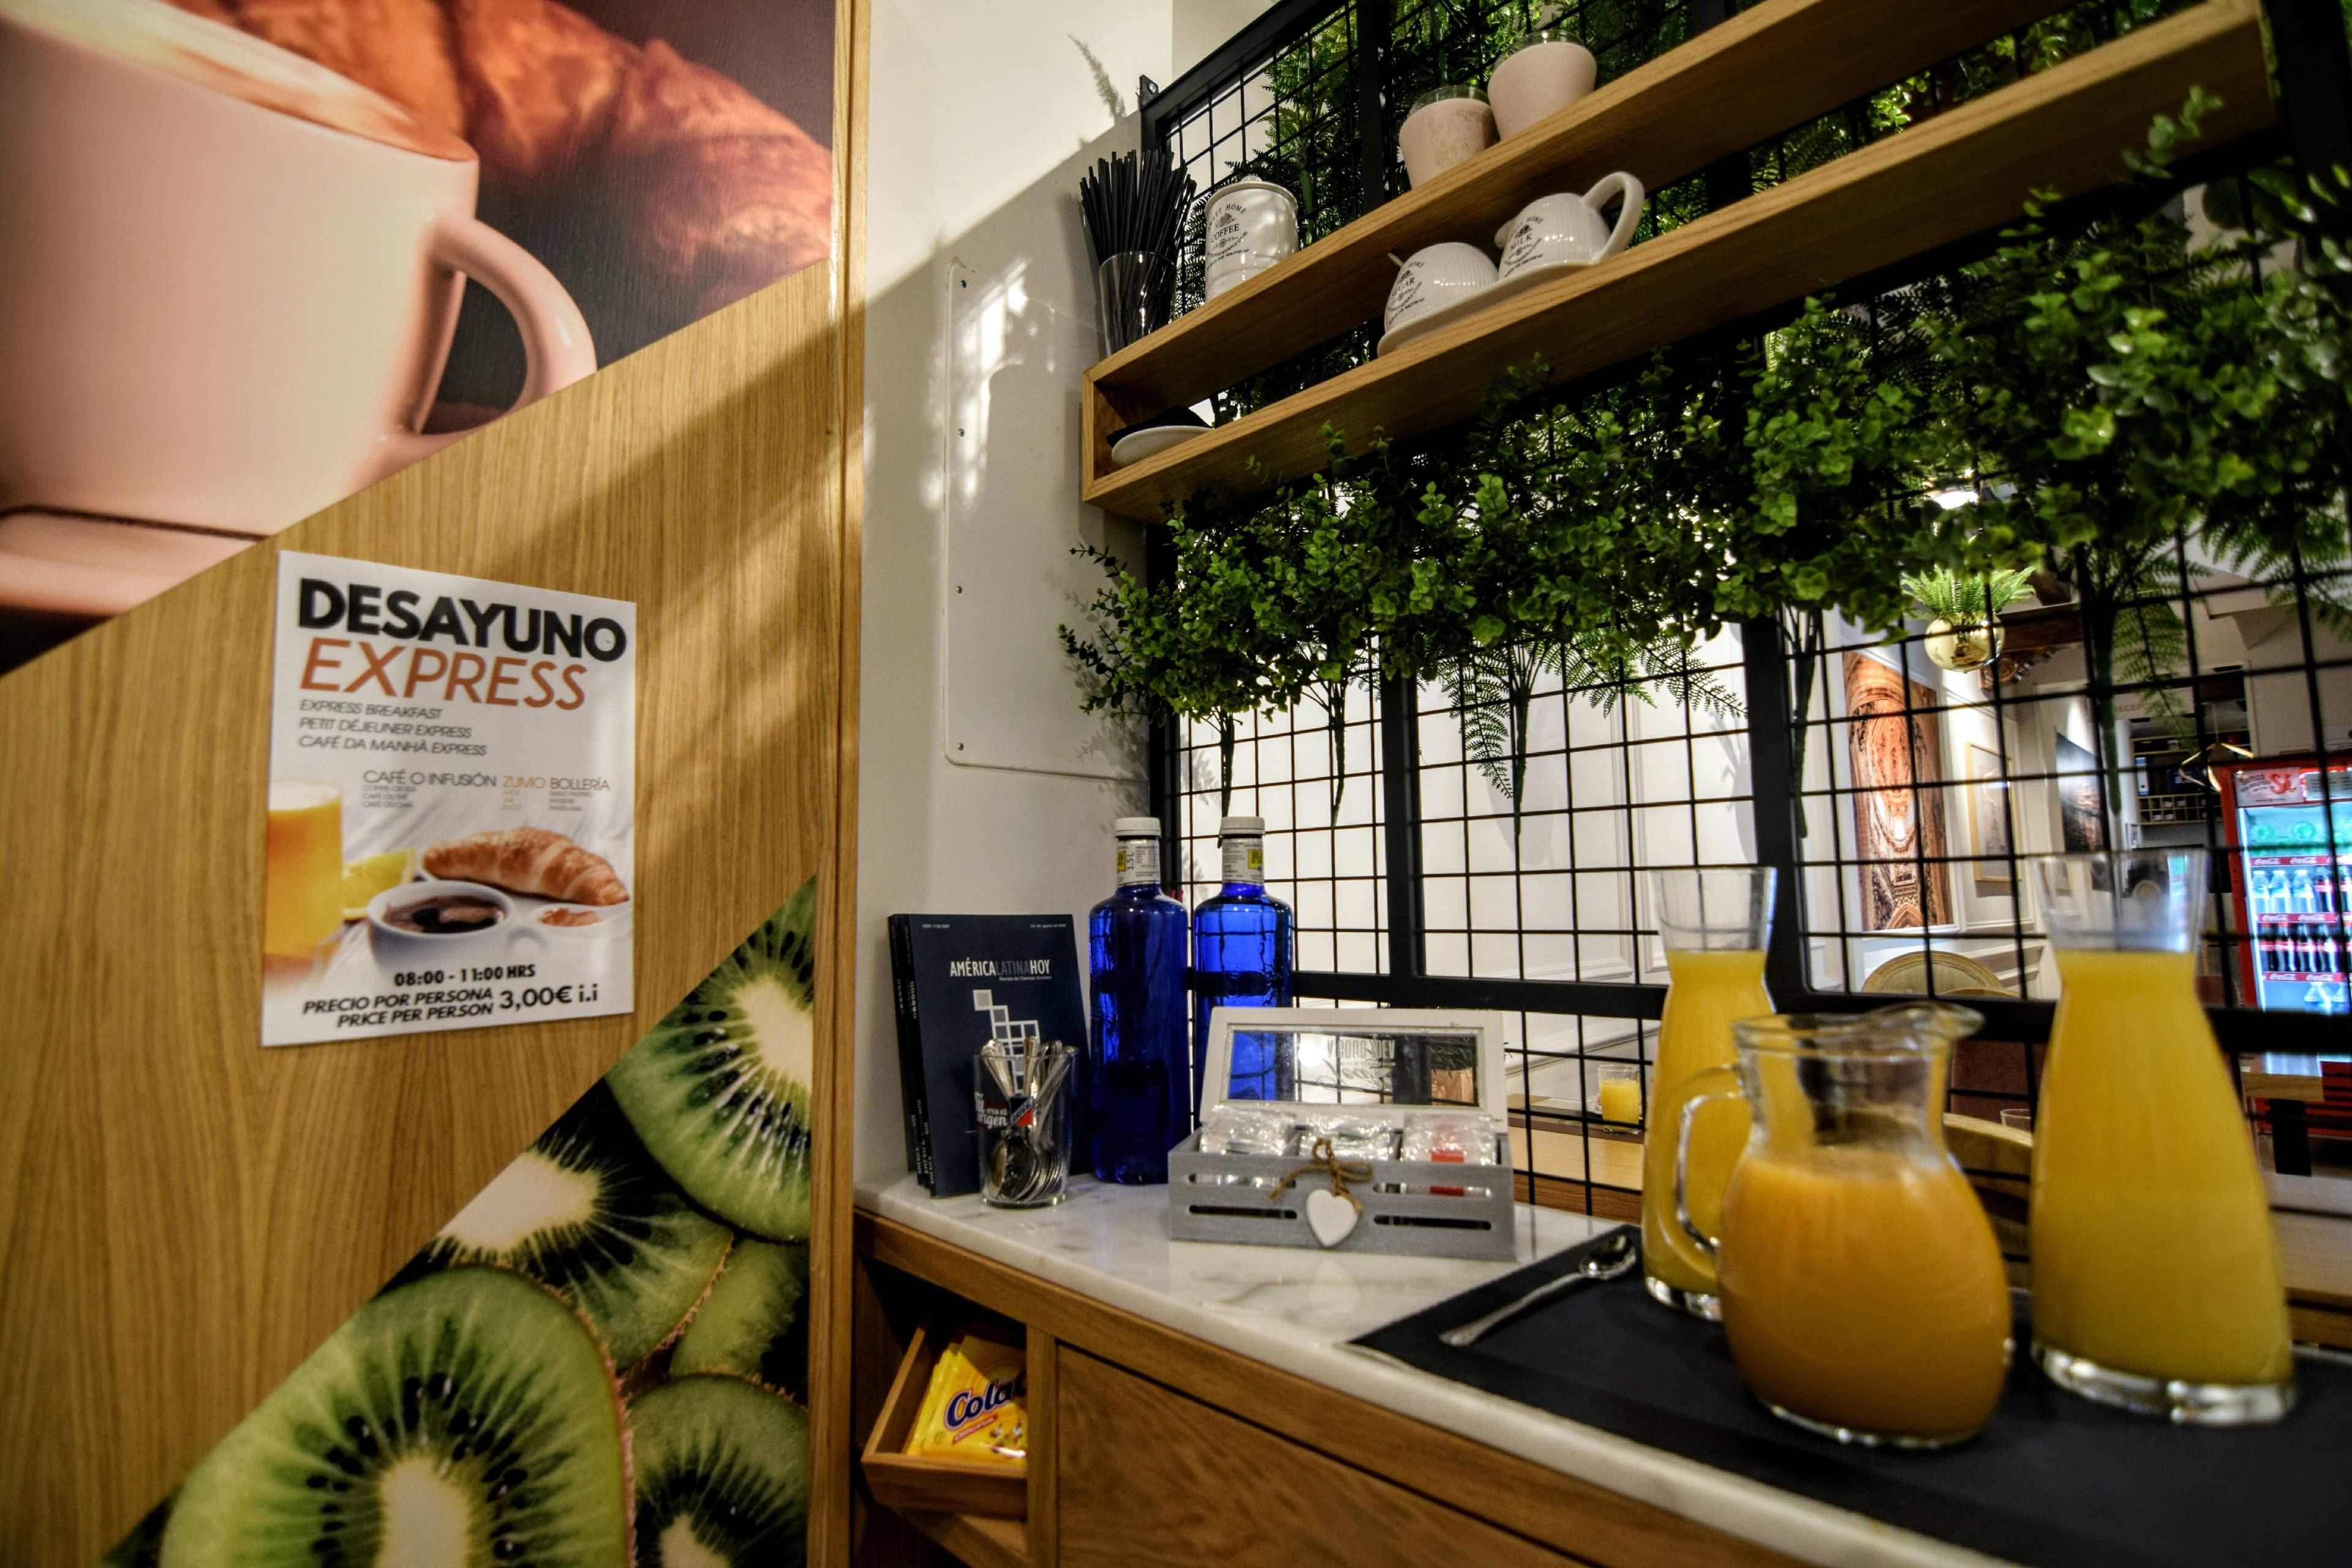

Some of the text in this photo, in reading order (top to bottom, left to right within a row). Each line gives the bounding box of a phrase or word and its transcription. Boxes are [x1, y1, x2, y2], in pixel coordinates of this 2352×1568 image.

[1226, 204, 1247, 214] HOME
[1212, 224, 1240, 243] COFFEE
[298, 578, 627, 662] DESAYUNO
[300, 637, 588, 710] EXPRESS
[299, 699, 443, 719] EXPRESS BREAKFAST
[299, 717, 473, 738] PETIT DÉJEUNER EXPRESS
[298, 734, 341, 749] CAFÉ
[343, 737, 367, 749] DA
[431, 742, 488, 756] EXPRESS
[363, 769, 611, 791] CAFÉ O INFUSIÓN ZUMO BOLLERÍA
[394, 971, 443, 986] 08:00
[461, 967, 503, 982] 11:00
[507, 964, 536, 978] HRS
[303, 988, 492, 1014] PRECIO POR PERSONA
[499, 985, 573, 1011] 3,00€
[337, 1002, 493, 1028] PRICE PER PERSON
